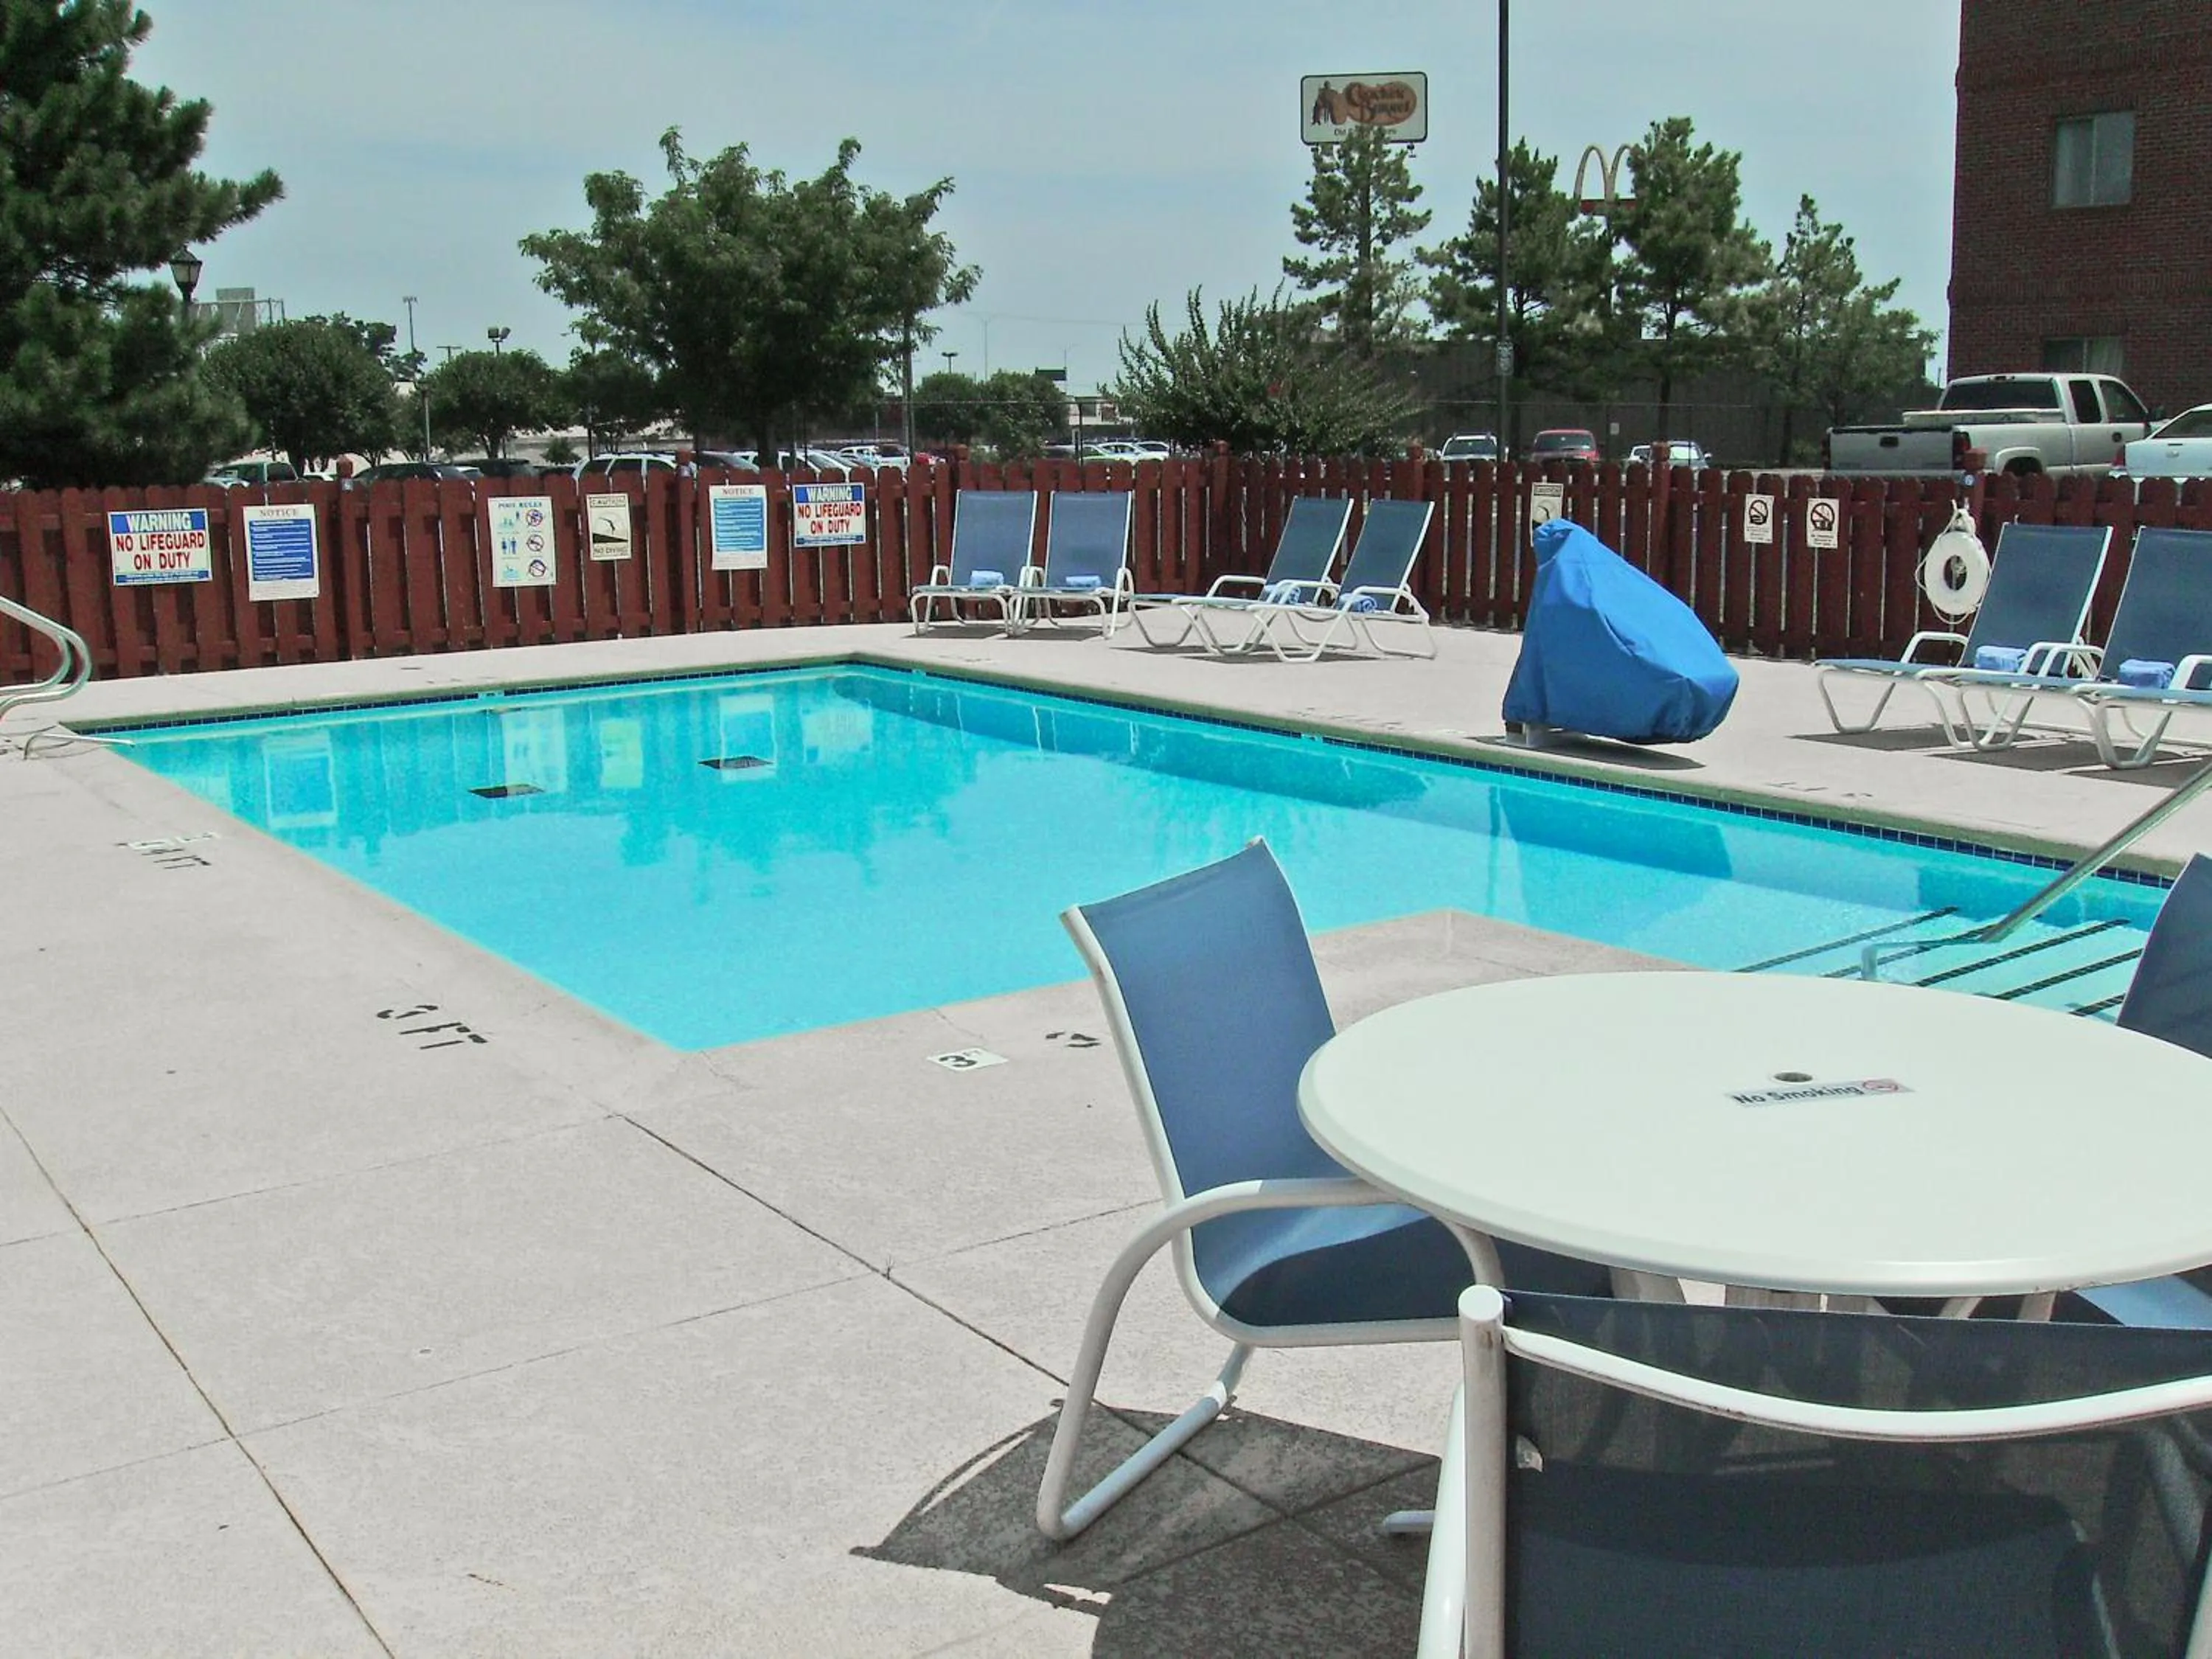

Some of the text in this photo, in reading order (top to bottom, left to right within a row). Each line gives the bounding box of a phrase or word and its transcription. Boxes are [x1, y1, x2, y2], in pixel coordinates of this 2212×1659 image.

[807, 486, 853, 502] WARNING
[798, 503, 862, 518] NO LIFEGUARD
[126, 512, 192, 532] WARNING
[810, 520, 850, 535] ON DUTY
[116, 532, 205, 552] NO LIFEGUARD
[134, 552, 190, 571] ON DUTY
[939, 1054, 977, 1068] 3
[1733, 1085, 1865, 1104] No Smoking
